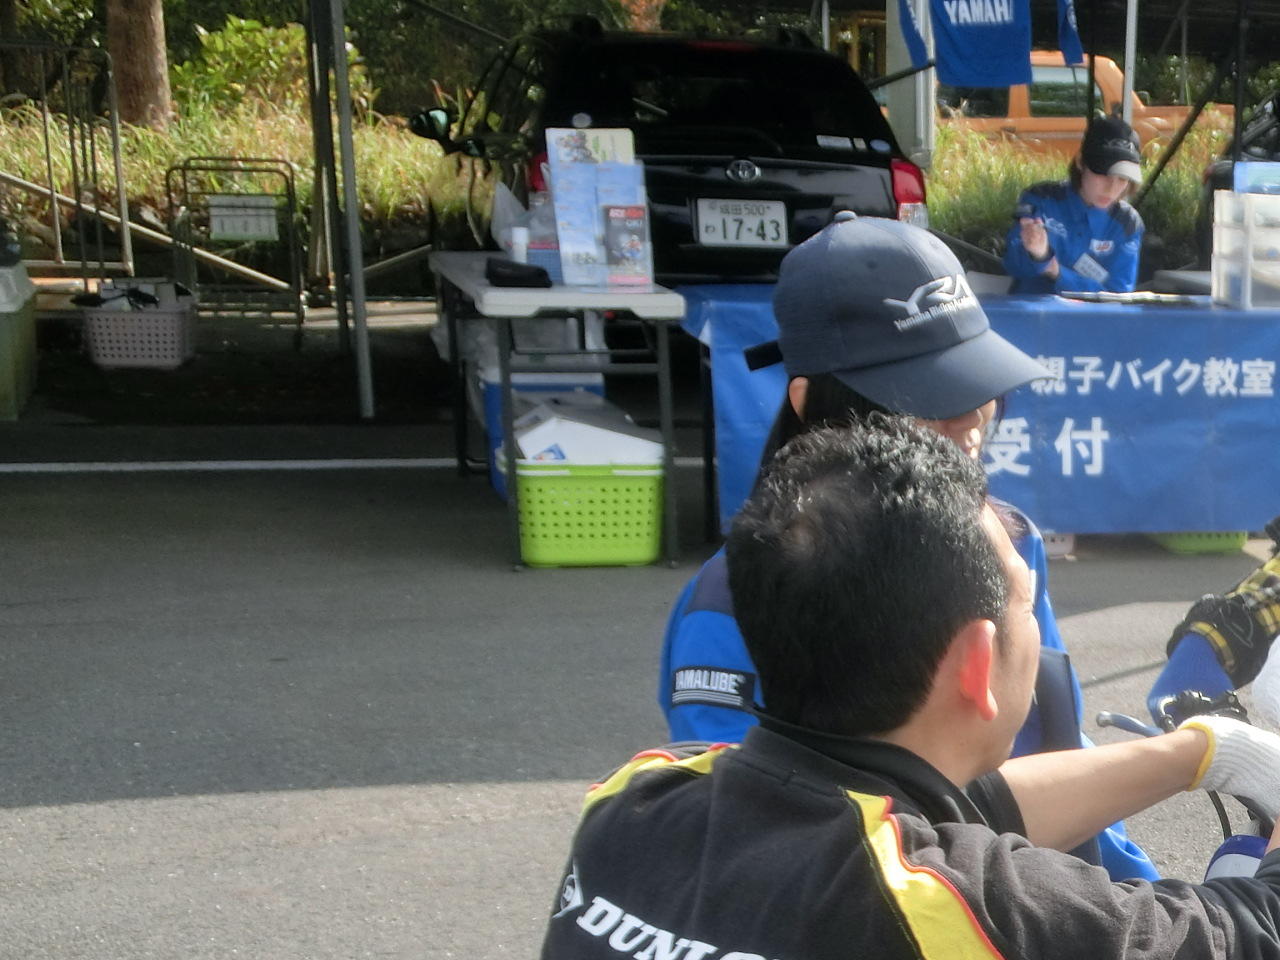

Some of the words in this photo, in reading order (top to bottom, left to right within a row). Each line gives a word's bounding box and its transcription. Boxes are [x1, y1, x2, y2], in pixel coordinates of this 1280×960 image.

[944, 0, 1014, 25] YAMAH
[722, 217, 781, 241] 17-43
[1030, 356, 1276, 396] 親子バイク教室
